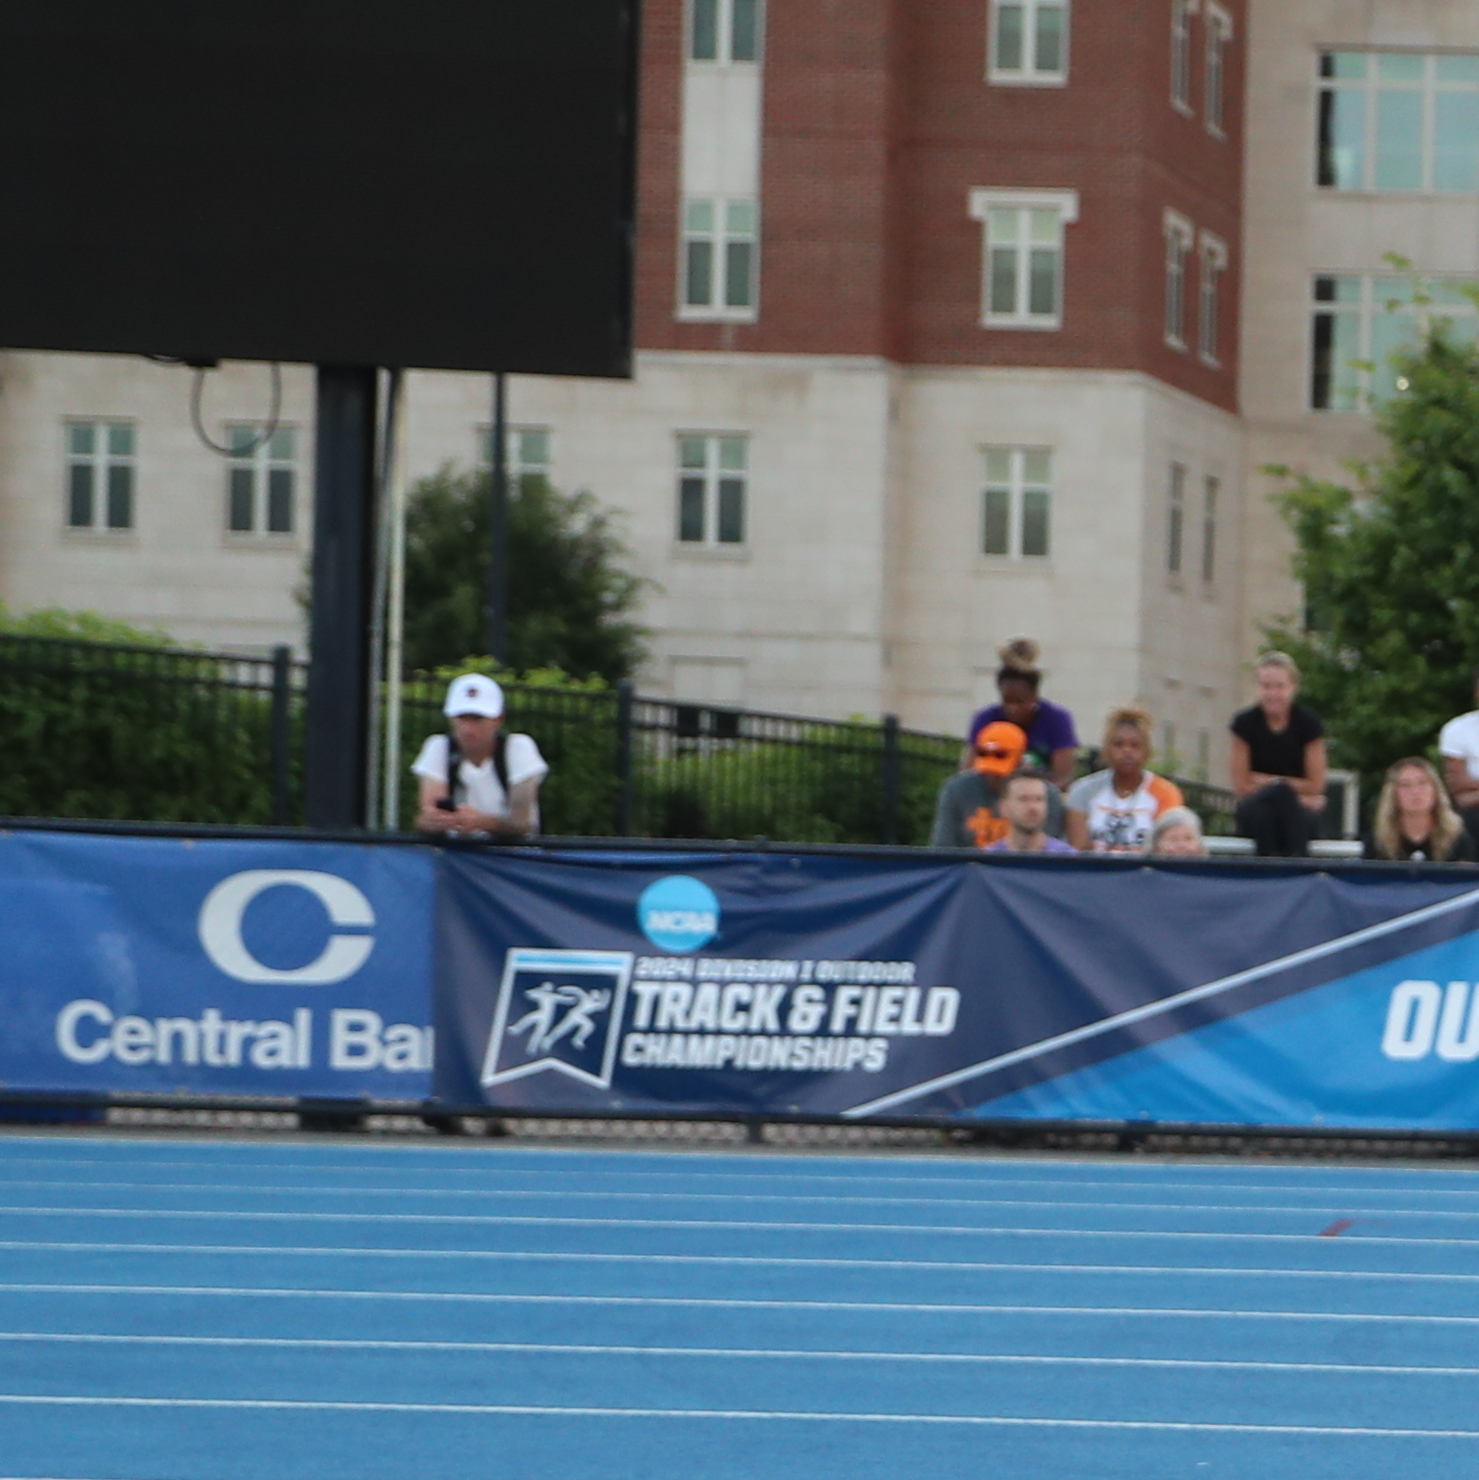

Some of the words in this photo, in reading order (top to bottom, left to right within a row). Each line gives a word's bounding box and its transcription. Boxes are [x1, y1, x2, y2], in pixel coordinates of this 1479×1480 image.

[634, 956, 694, 979] 2024
[696, 958, 799, 982] DIVISION
[815, 961, 915, 984] OUTDOOR
[631, 980, 788, 1033] TRACK
[788, 984, 827, 1034] &
[829, 985, 961, 1037] FIELD
[55, 999, 312, 1069] Central
[621, 1033, 889, 1073] CHAMPIONSHIPS
